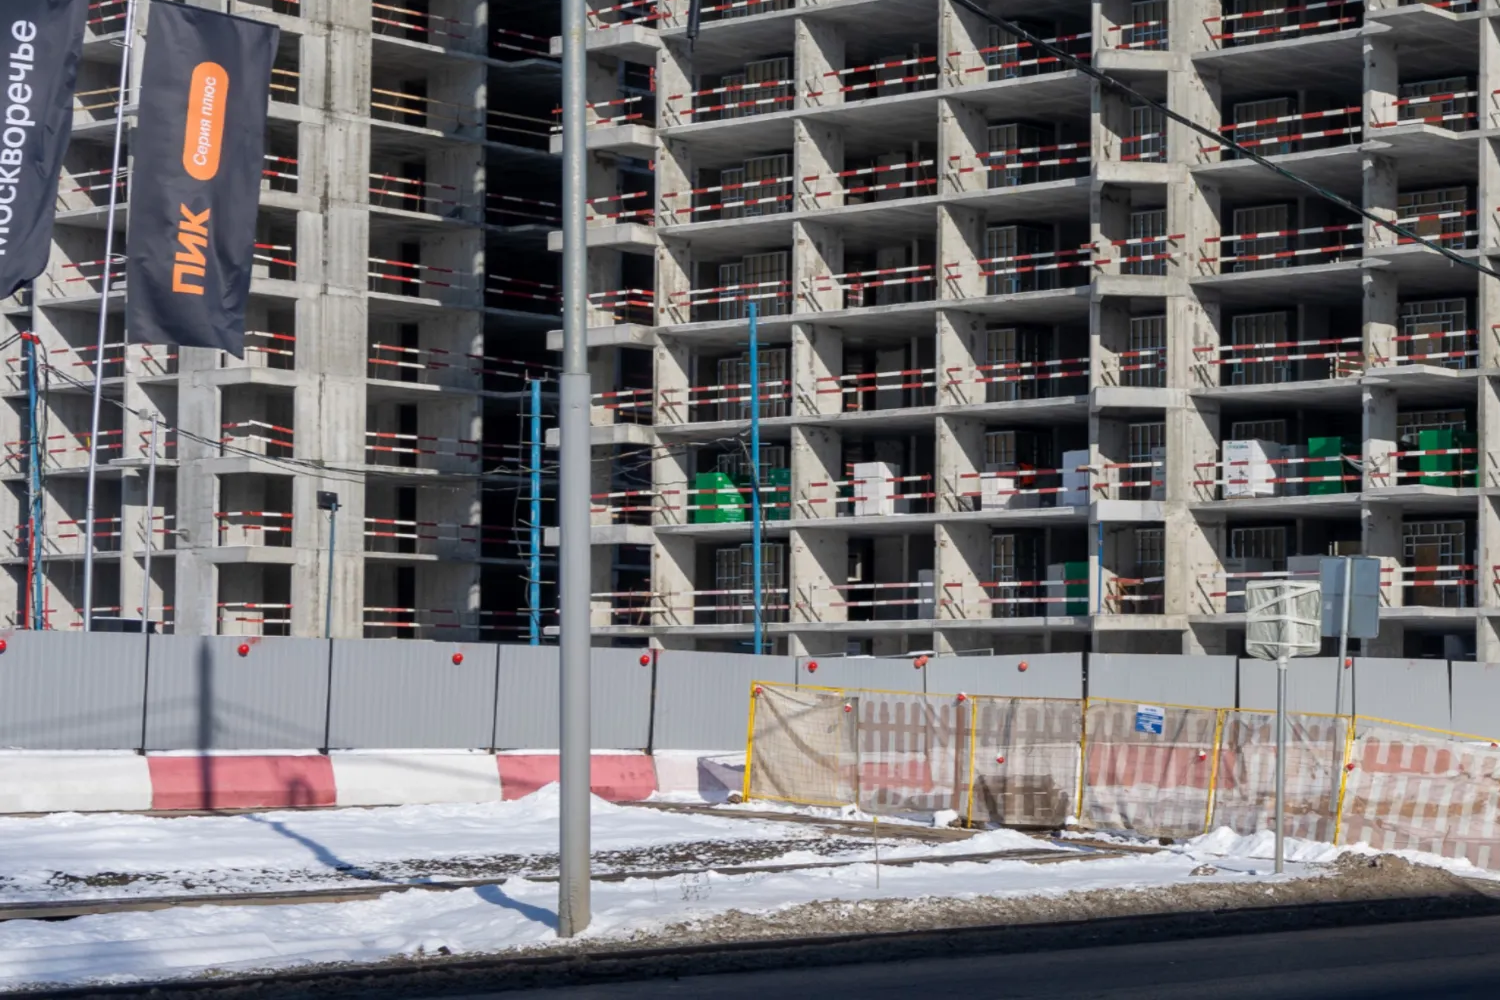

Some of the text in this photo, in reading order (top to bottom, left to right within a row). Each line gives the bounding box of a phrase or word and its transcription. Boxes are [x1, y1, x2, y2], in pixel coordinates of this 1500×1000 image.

[0, 20, 37, 255] оскворечье
[192, 76, 217, 166] Серия плюс
[172, 203, 210, 295] ПИК
